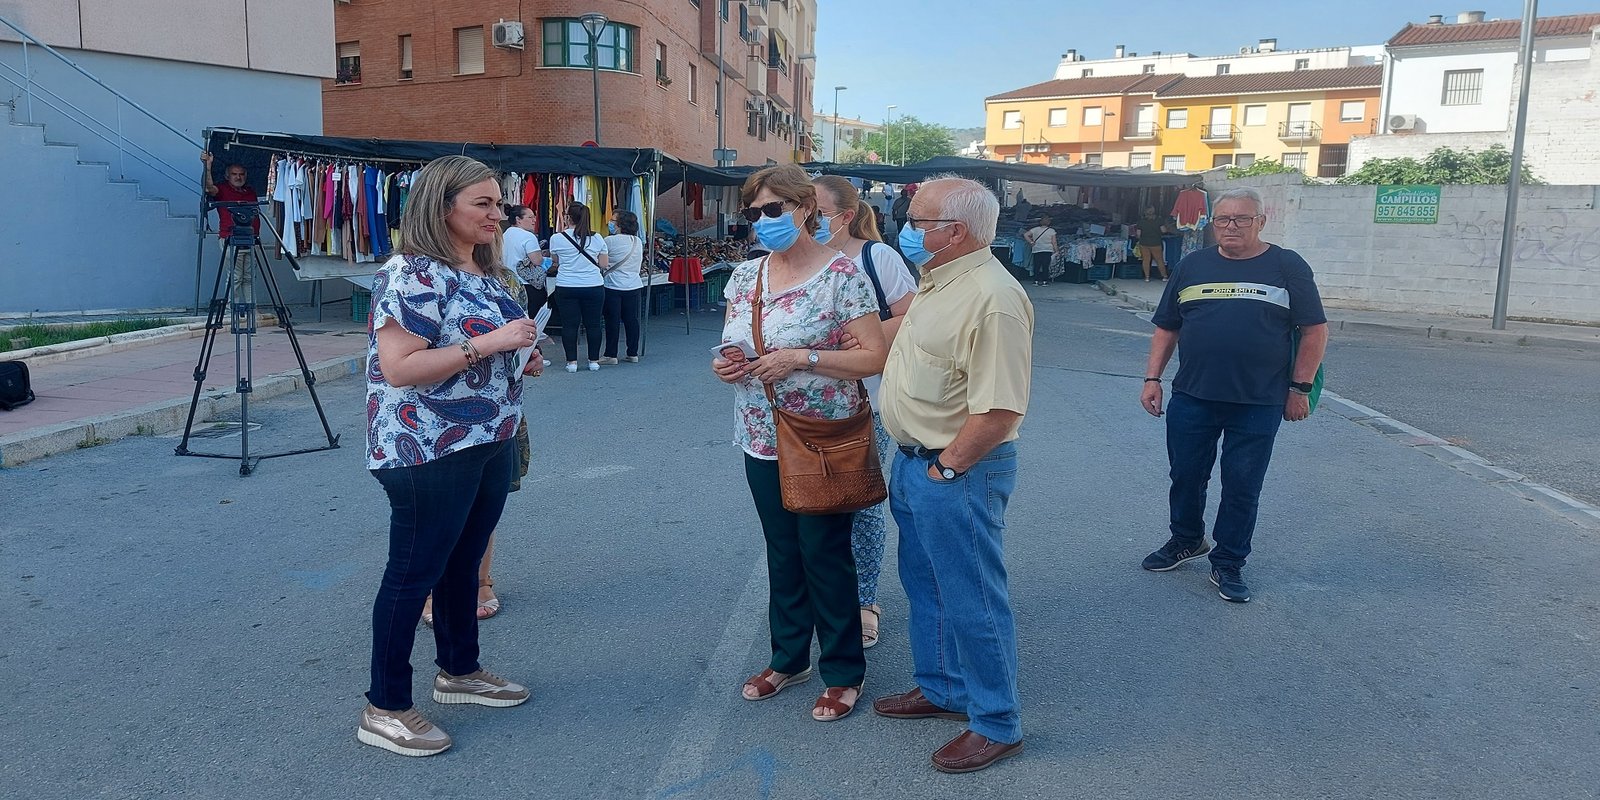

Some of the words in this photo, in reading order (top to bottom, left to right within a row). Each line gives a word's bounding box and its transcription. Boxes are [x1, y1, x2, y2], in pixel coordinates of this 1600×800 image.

[1380, 195, 1438, 204] CAMPILLOS
[1378, 206, 1396, 216] 957
[1397, 206, 1416, 217] 845
[1416, 206, 1435, 217] 855
